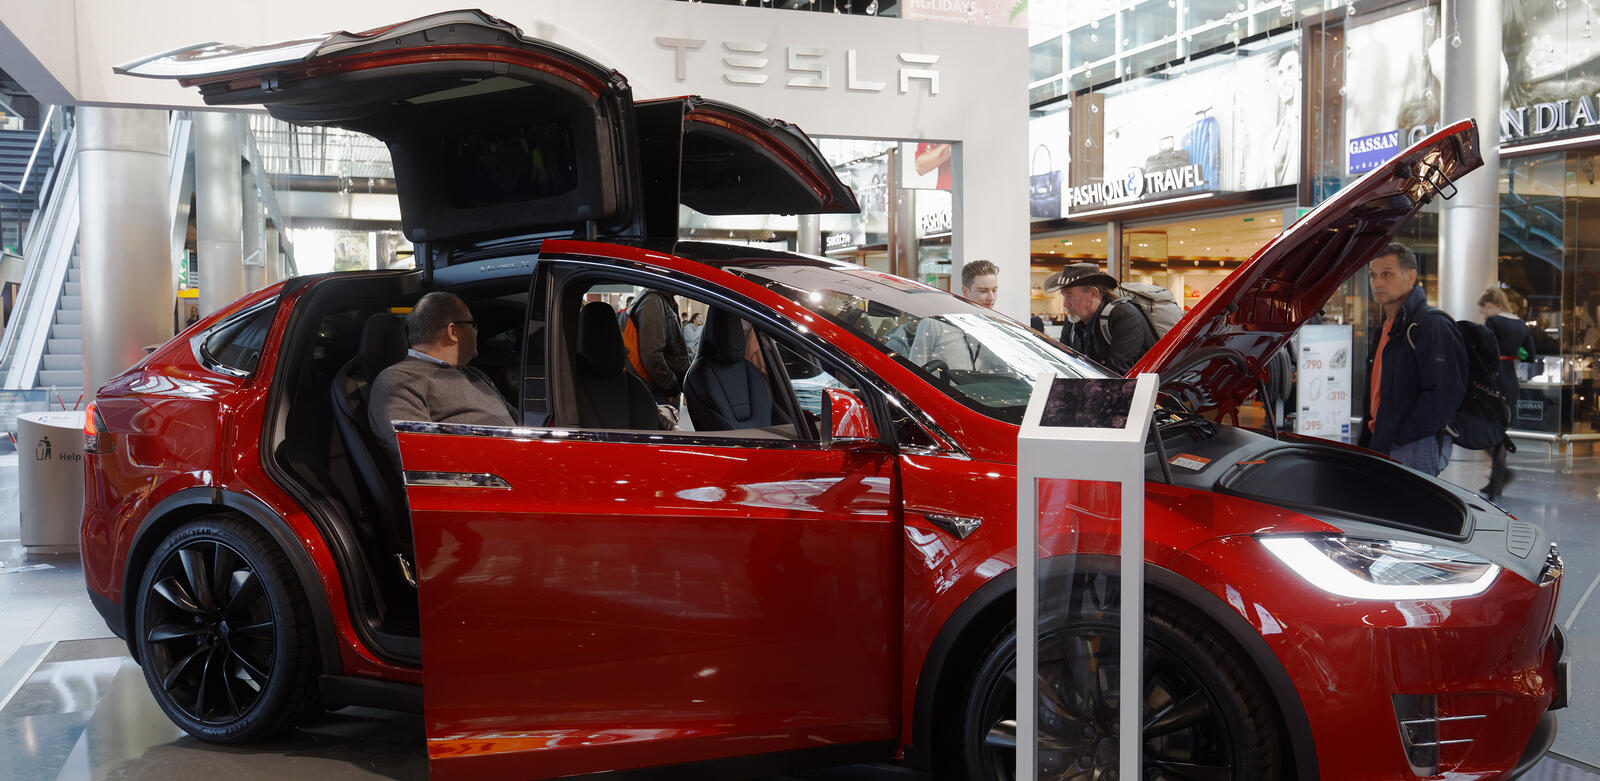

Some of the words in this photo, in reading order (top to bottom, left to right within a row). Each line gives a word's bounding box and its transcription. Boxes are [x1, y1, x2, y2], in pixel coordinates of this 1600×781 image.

[655, 36, 941, 96] TESLA
[1534, 93, 1600, 134] DIA
[1350, 132, 1399, 155] GASSAN
[1068, 179, 1125, 207] FASHION
[1144, 164, 1205, 194] TRAVEL
[60, 453, 82, 462] Help
